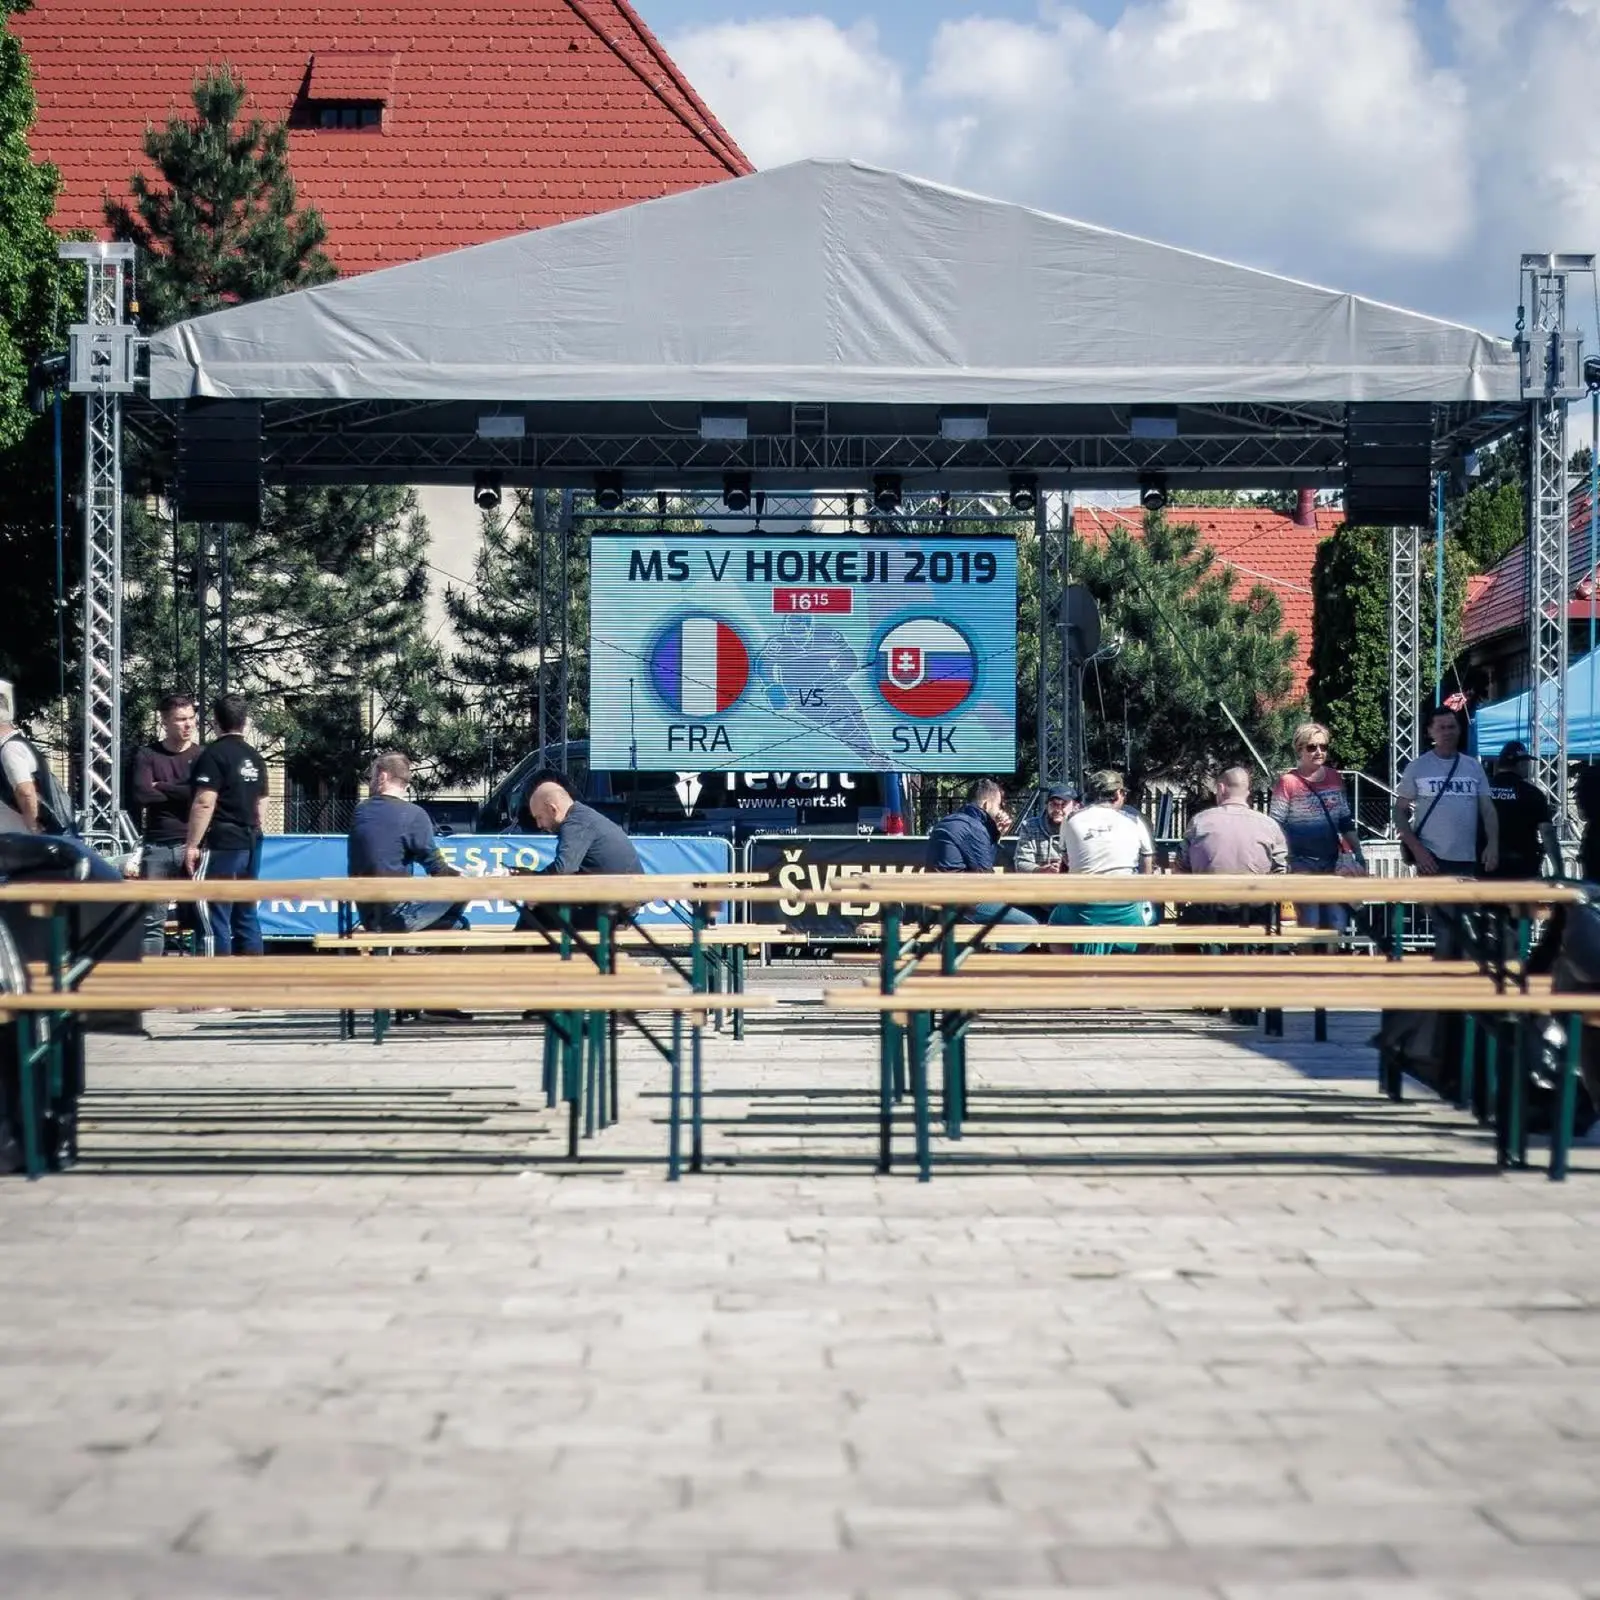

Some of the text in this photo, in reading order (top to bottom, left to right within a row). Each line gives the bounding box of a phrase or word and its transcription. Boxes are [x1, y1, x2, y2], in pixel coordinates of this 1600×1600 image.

[628, 550, 997, 583] MS V HOKEJI 2019
[667, 725, 733, 752] FRA
[892, 726, 957, 753] SVK
[737, 793, 846, 809] www.revart.sk
